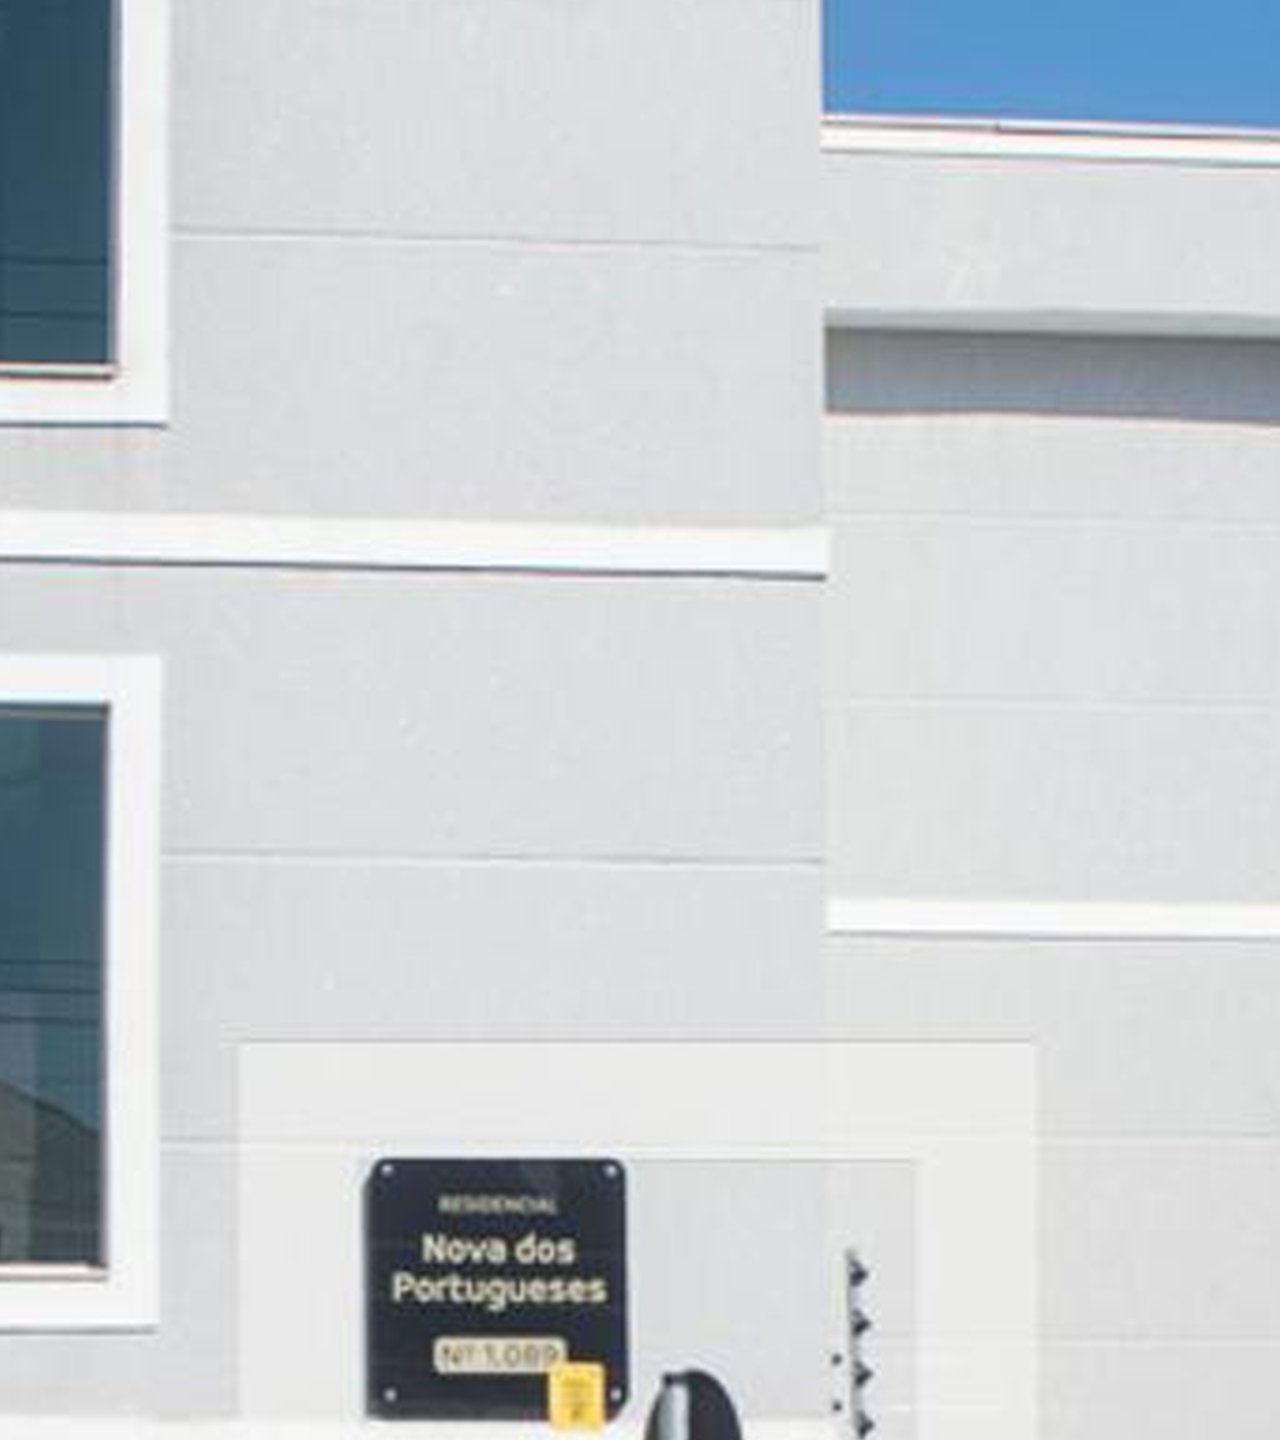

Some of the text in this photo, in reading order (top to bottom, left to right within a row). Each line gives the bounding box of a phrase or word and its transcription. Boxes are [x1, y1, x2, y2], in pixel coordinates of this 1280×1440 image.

[437, 1196, 557, 1213] RESIDENCIAL
[422, 1232, 575, 1264] Nova dos
[392, 1272, 608, 1312] Portugueses
